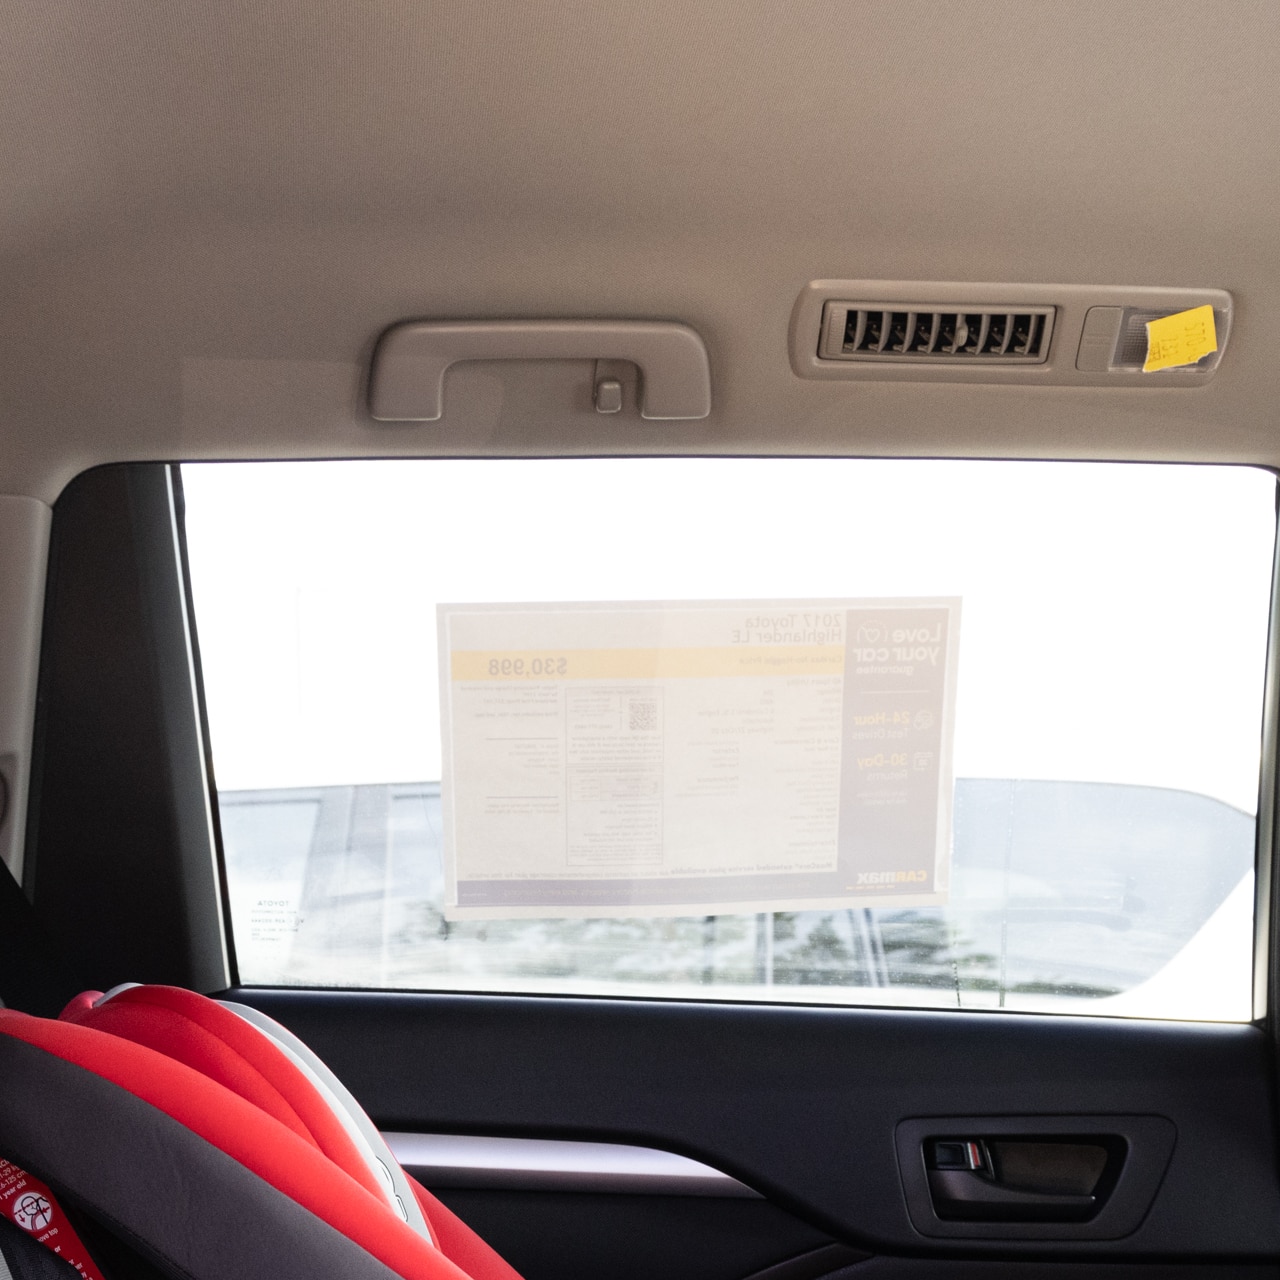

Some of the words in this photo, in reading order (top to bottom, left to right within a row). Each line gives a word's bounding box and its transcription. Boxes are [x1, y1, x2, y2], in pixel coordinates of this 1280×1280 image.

[3, 1187, 18, 1198] year
[16, 1180, 27, 1189] old
[49, 1228, 59, 1236] top
